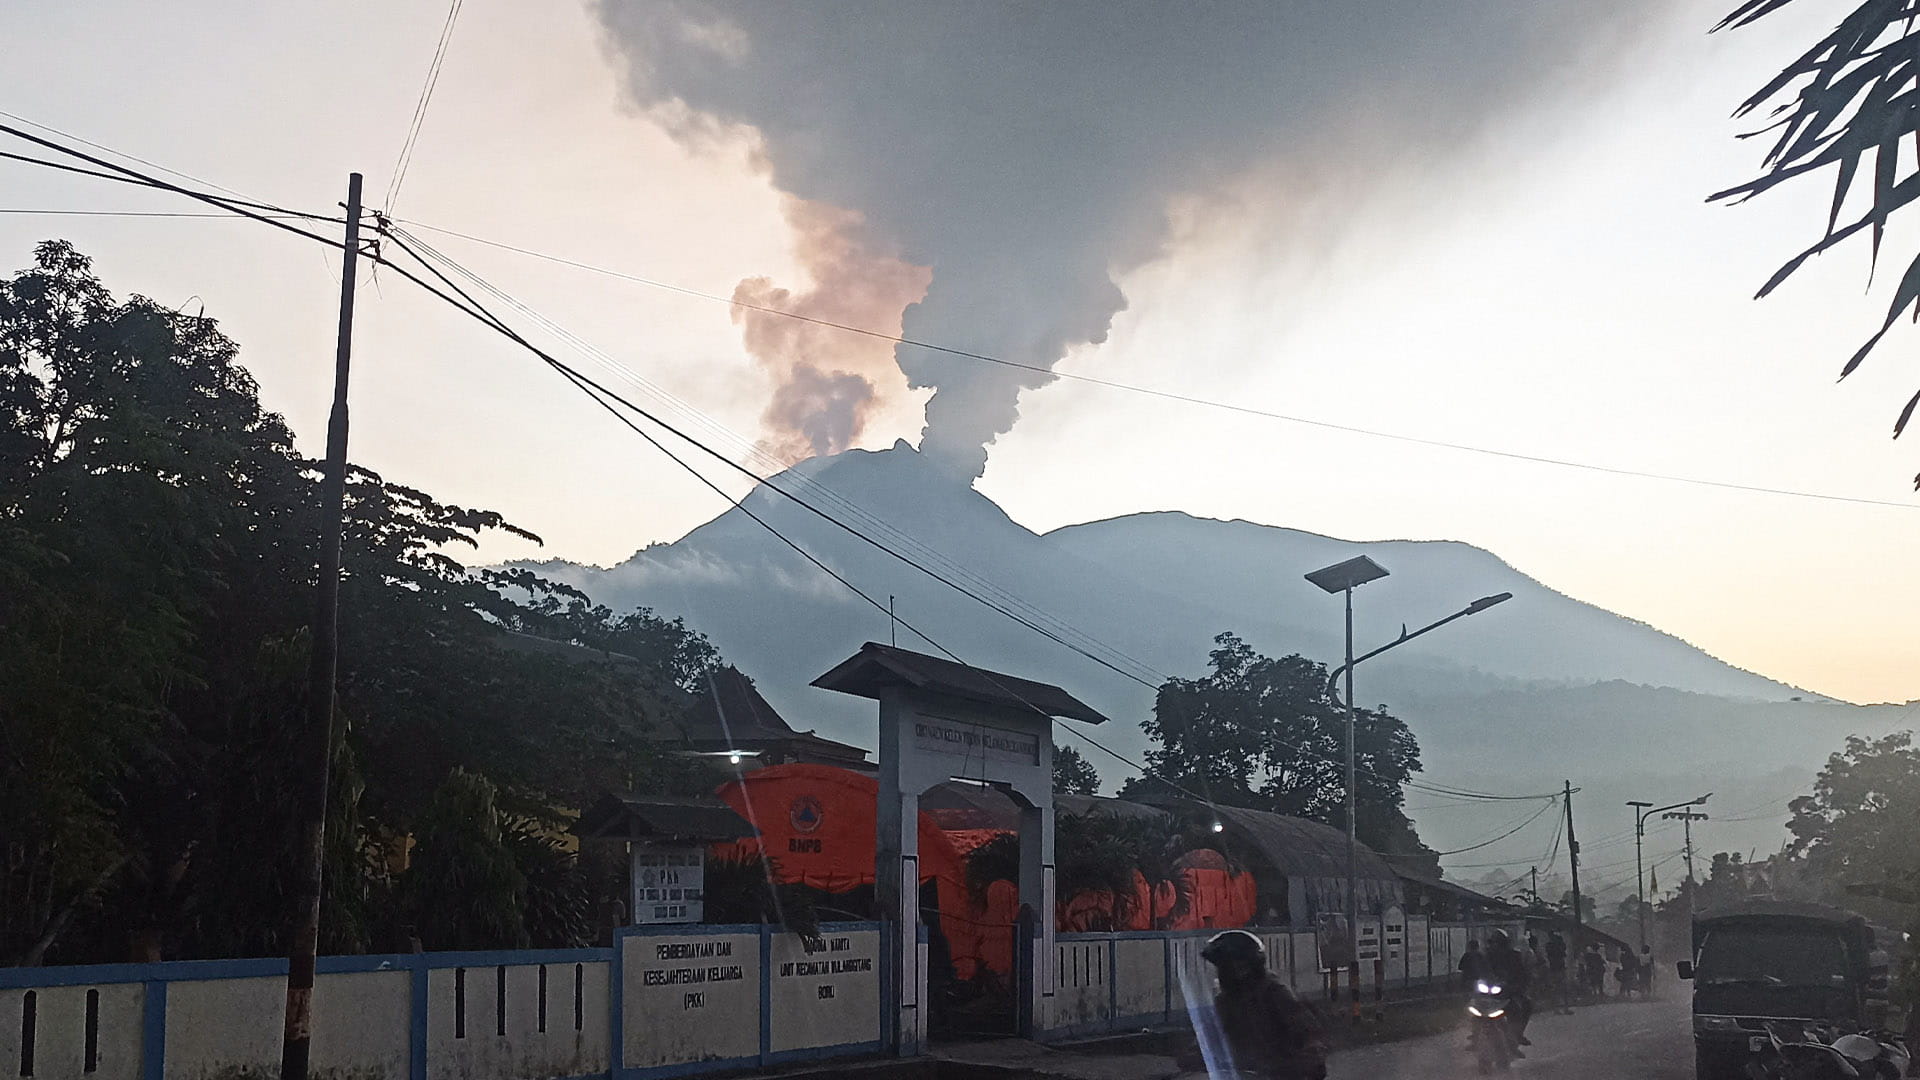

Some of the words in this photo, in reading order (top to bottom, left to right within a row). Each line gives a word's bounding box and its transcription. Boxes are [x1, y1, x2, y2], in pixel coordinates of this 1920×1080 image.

[788, 838, 822, 853] BNPB
[656, 943, 714, 960] PEMBERDAYAAN
[717, 942, 732, 956] DAN
[643, 968, 706, 986] KESEJAHTERAAN
[707, 966, 743, 982] KELUARGA
[780, 963, 794, 977] UNIT
[796, 961, 829, 976] KECAMATAN
[684, 992, 705, 1011] (PKK)
